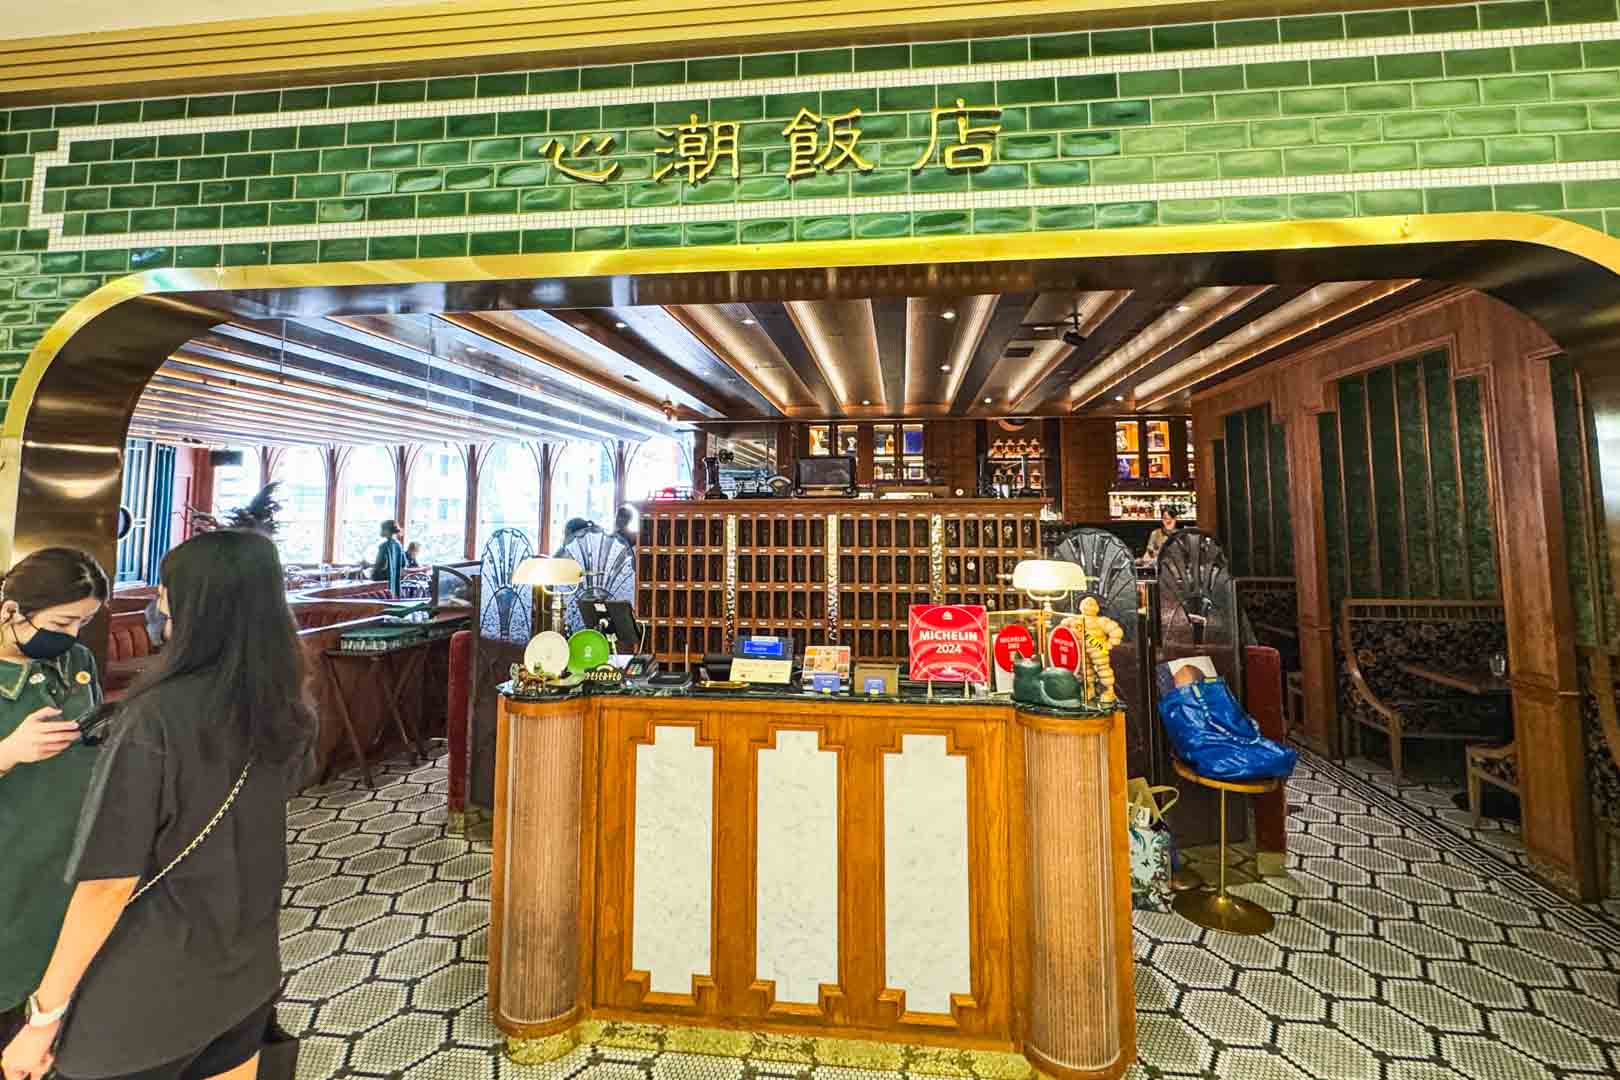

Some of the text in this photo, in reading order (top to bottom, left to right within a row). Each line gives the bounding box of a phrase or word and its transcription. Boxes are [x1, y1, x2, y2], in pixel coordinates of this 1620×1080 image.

[538, 98, 1003, 184] 心潮飯店
[919, 630, 978, 641] MICHELIN
[935, 643, 962, 654] 2024
